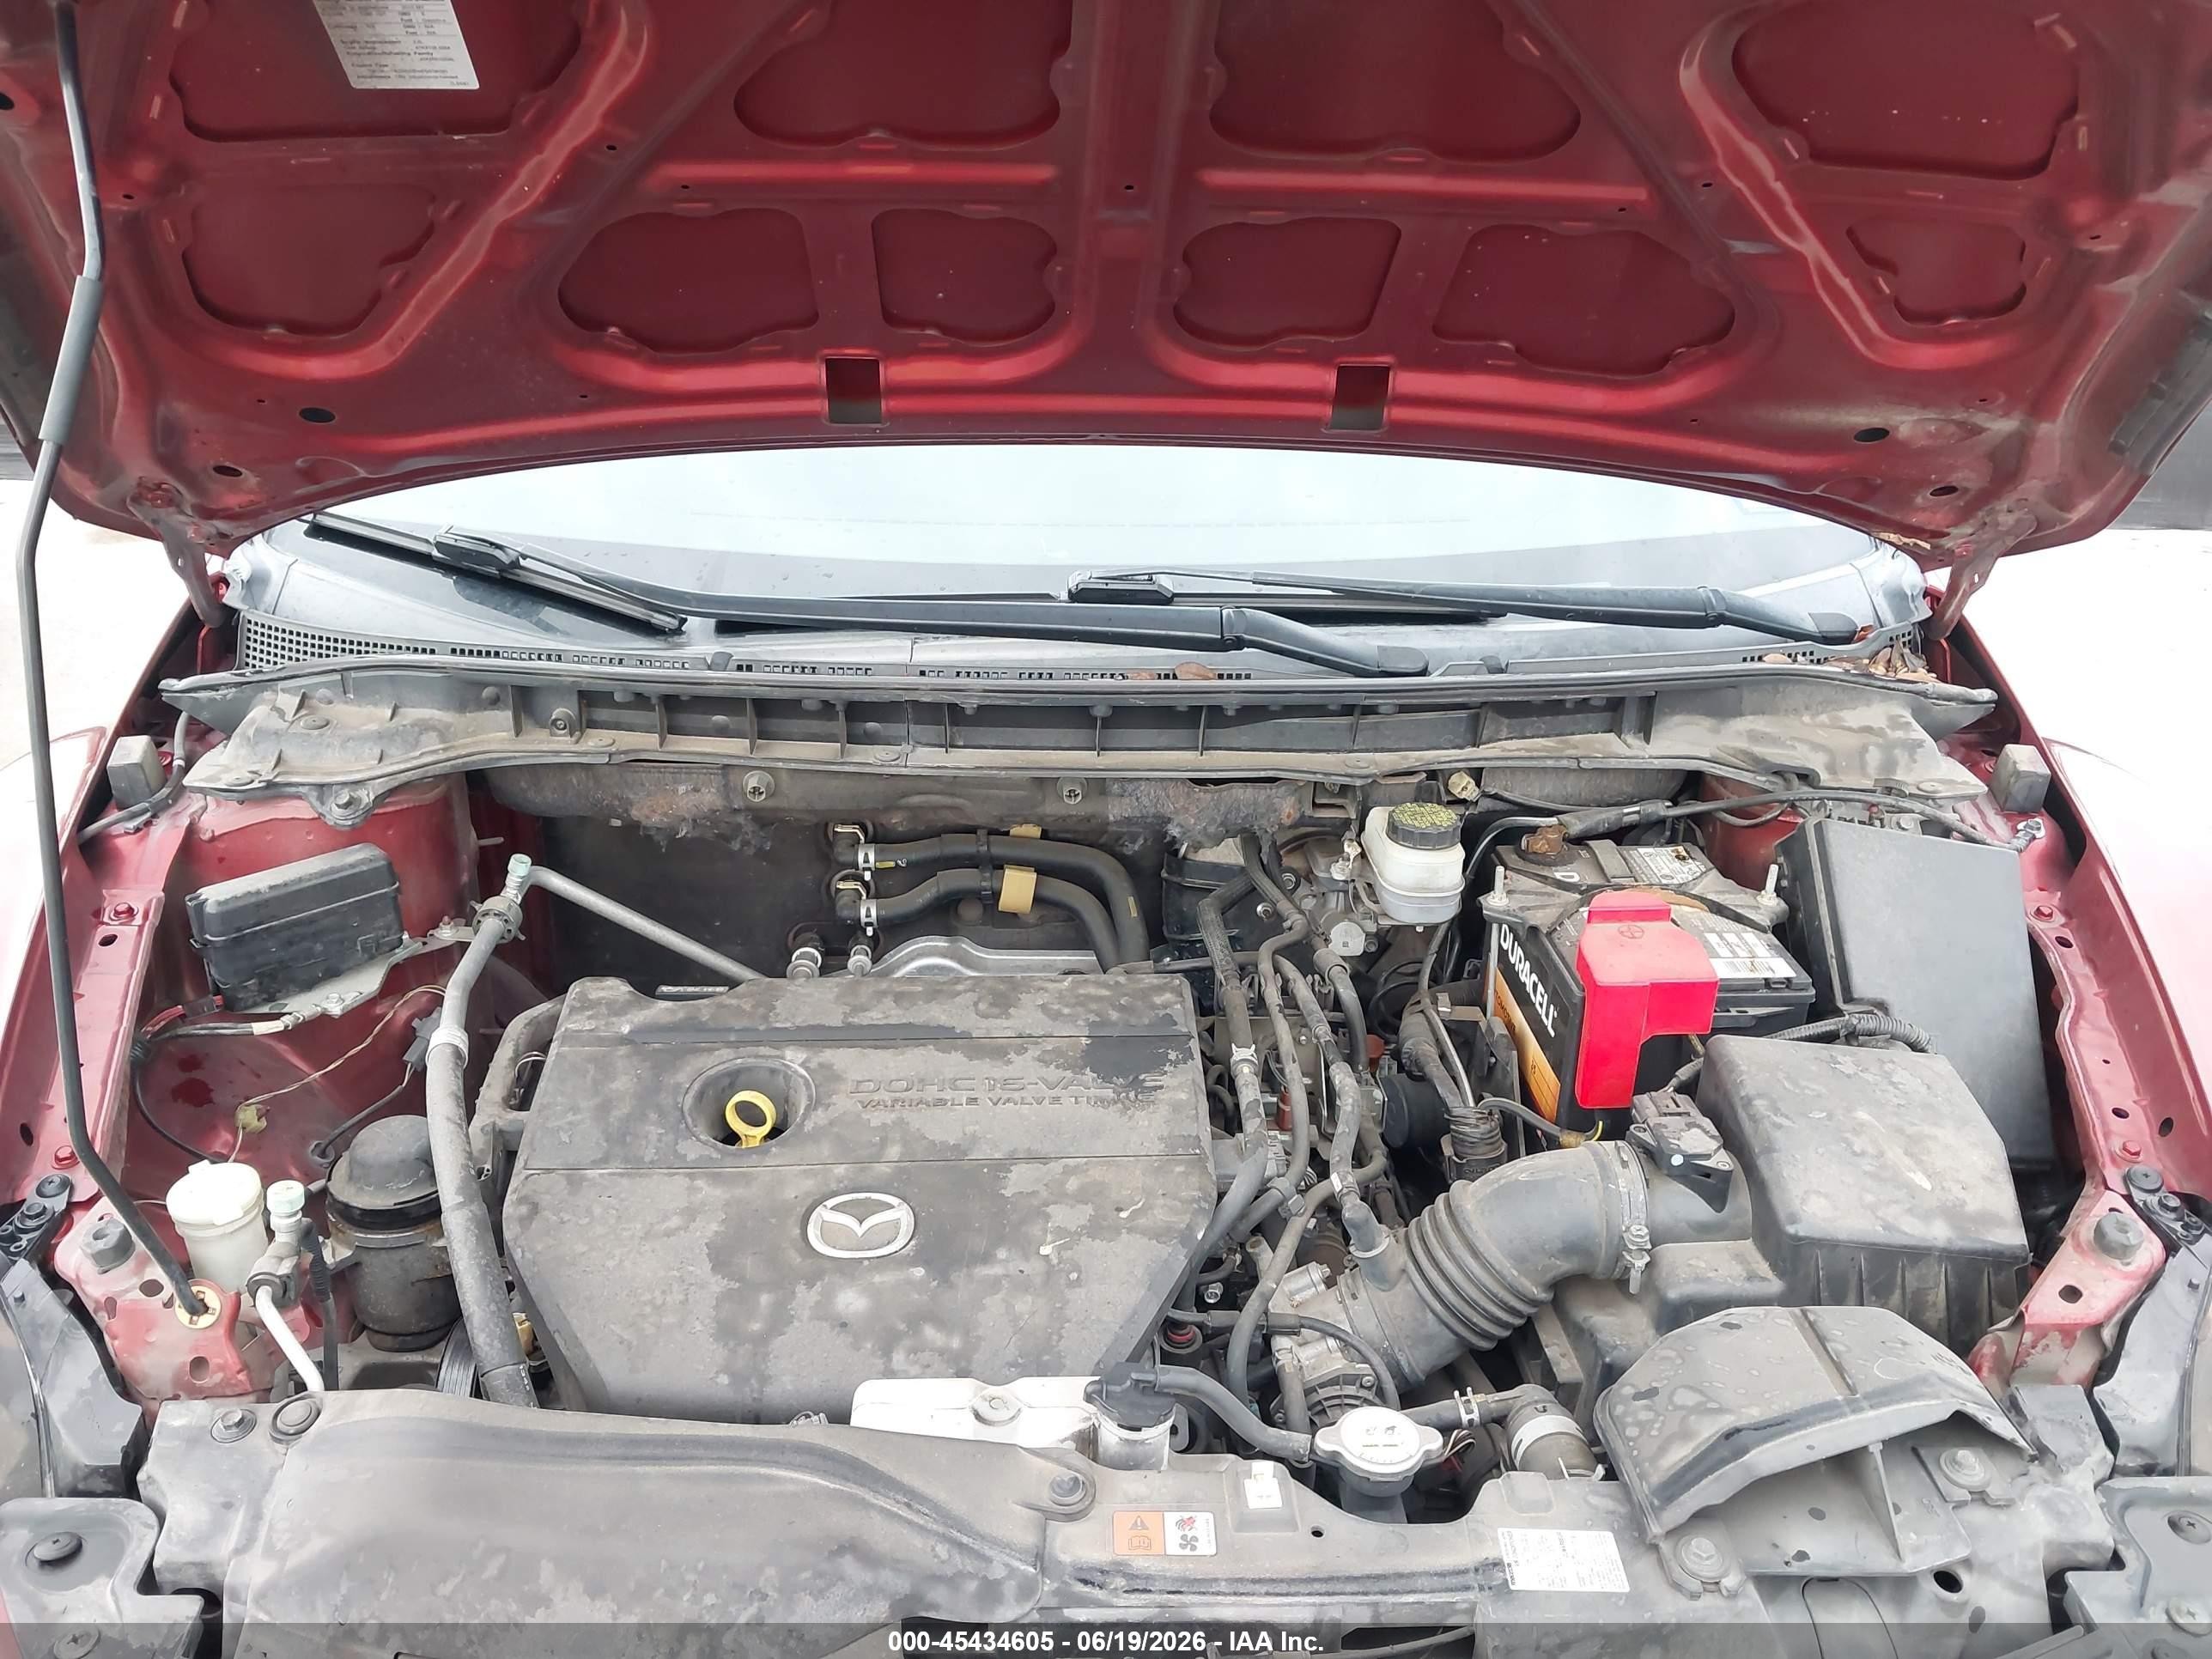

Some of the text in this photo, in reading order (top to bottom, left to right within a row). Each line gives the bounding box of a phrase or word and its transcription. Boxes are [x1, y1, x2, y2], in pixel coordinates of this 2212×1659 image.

[1500, 923, 1555, 1038] DURACELL
[849, 1077, 976, 1094] DOHC
[857, 1096, 980, 1109] VARIABLE
[986, 1095, 1063, 1107] VALVE
